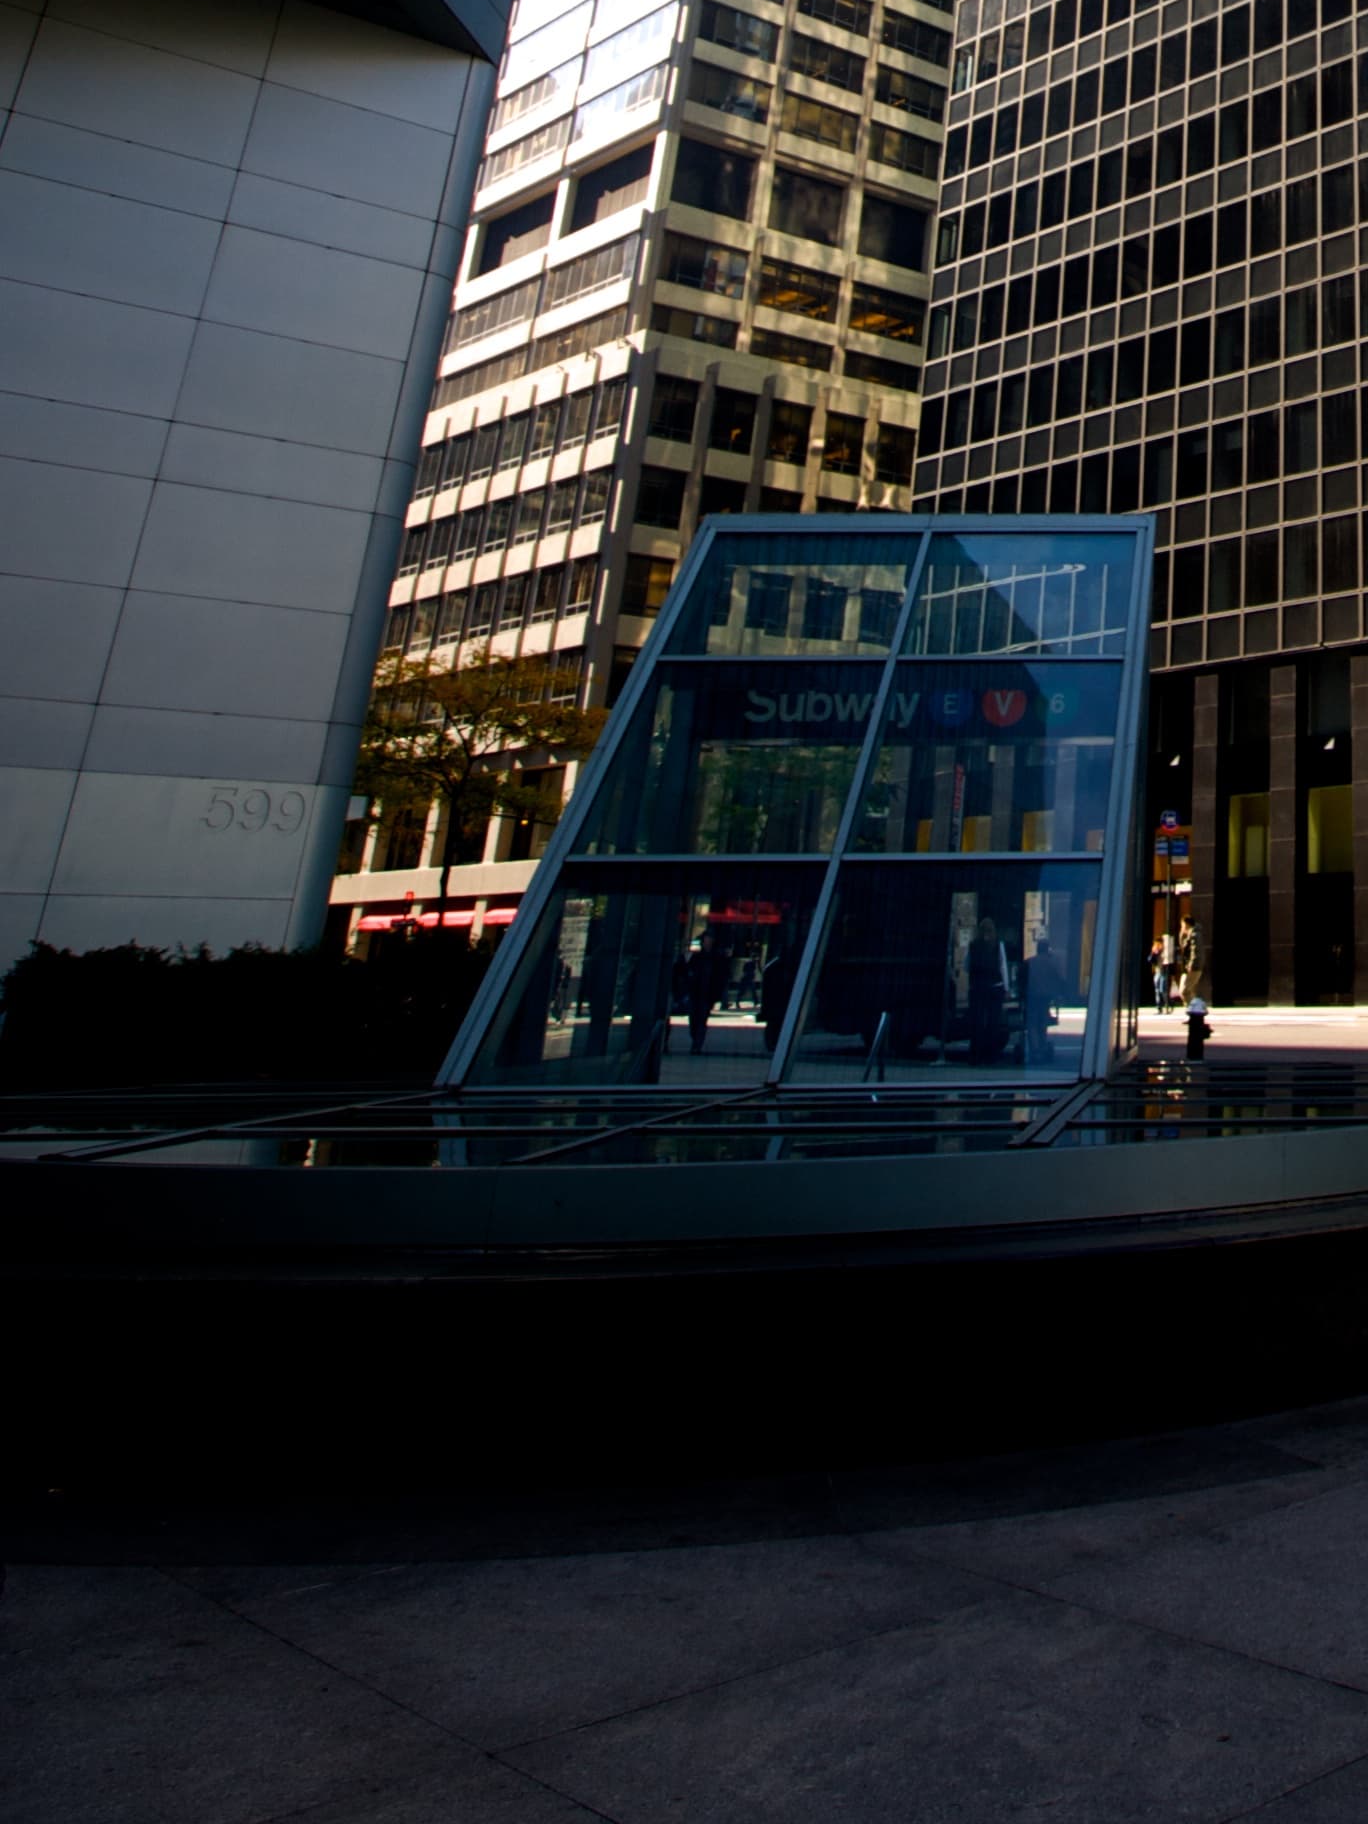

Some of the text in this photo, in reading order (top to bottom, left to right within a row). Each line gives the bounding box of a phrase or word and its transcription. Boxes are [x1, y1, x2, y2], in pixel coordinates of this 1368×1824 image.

[943, 692, 959, 715] E
[993, 690, 1017, 717] V
[1048, 692, 1066, 715] 6
[200, 786, 307, 836] 599
